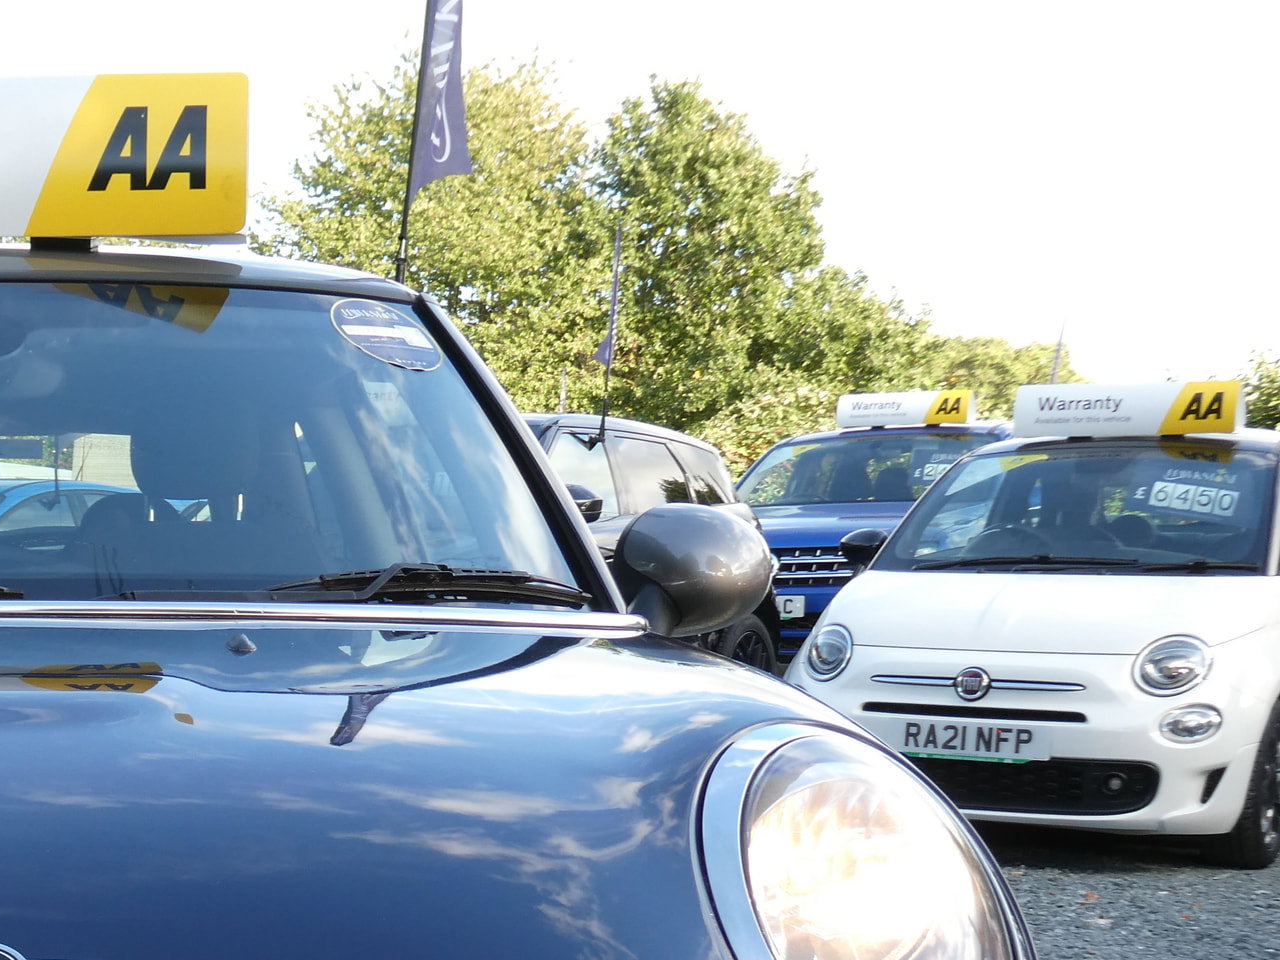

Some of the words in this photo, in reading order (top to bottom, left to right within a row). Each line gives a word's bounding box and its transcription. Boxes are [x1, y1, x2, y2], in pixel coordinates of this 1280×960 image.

[87, 105, 208, 191] AA
[851, 401, 902, 411] Warranty
[934, 397, 962, 415] AA
[1038, 395, 1123, 412] Warranty
[1179, 391, 1225, 421] AA
[904, 722, 967, 751] RA21
[975, 726, 1033, 754] NFP
